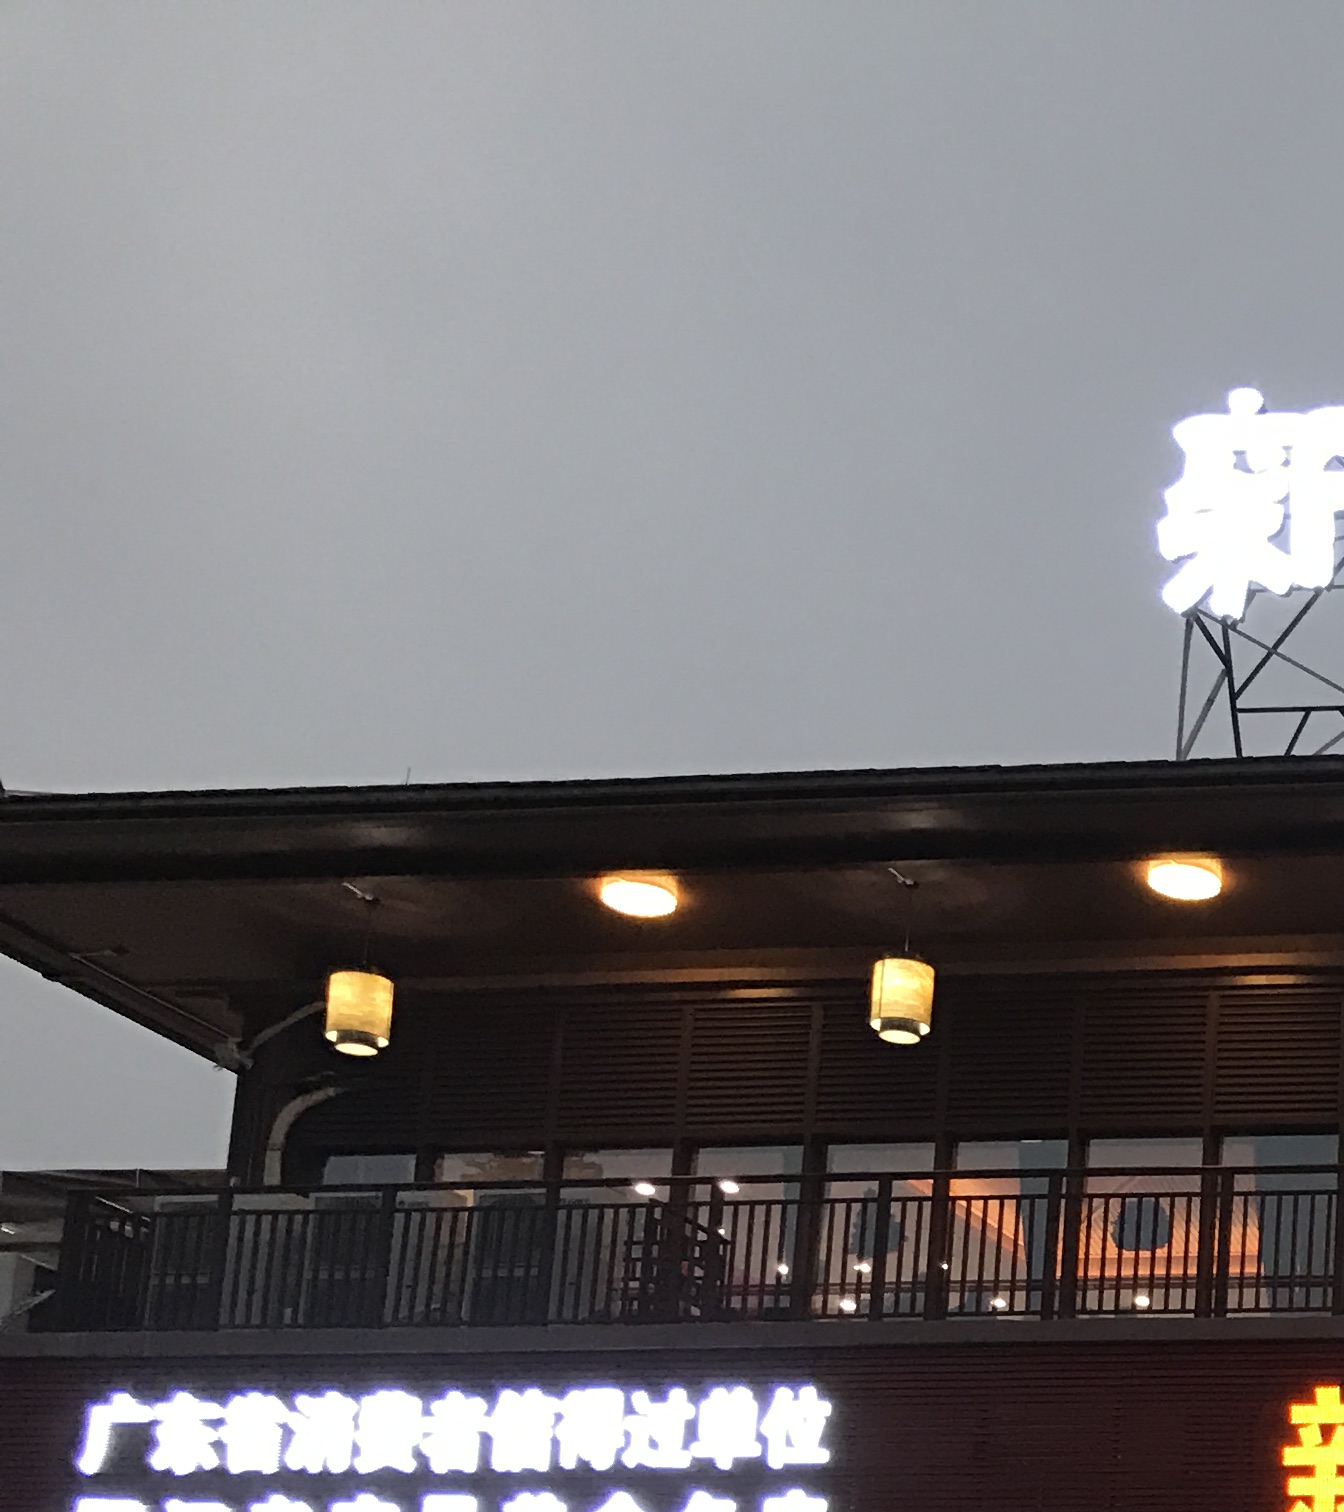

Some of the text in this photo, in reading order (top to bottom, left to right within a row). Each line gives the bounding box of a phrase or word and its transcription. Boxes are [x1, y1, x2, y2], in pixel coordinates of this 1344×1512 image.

[75, 1384, 833, 1476] 广东省消费者信得过单位
